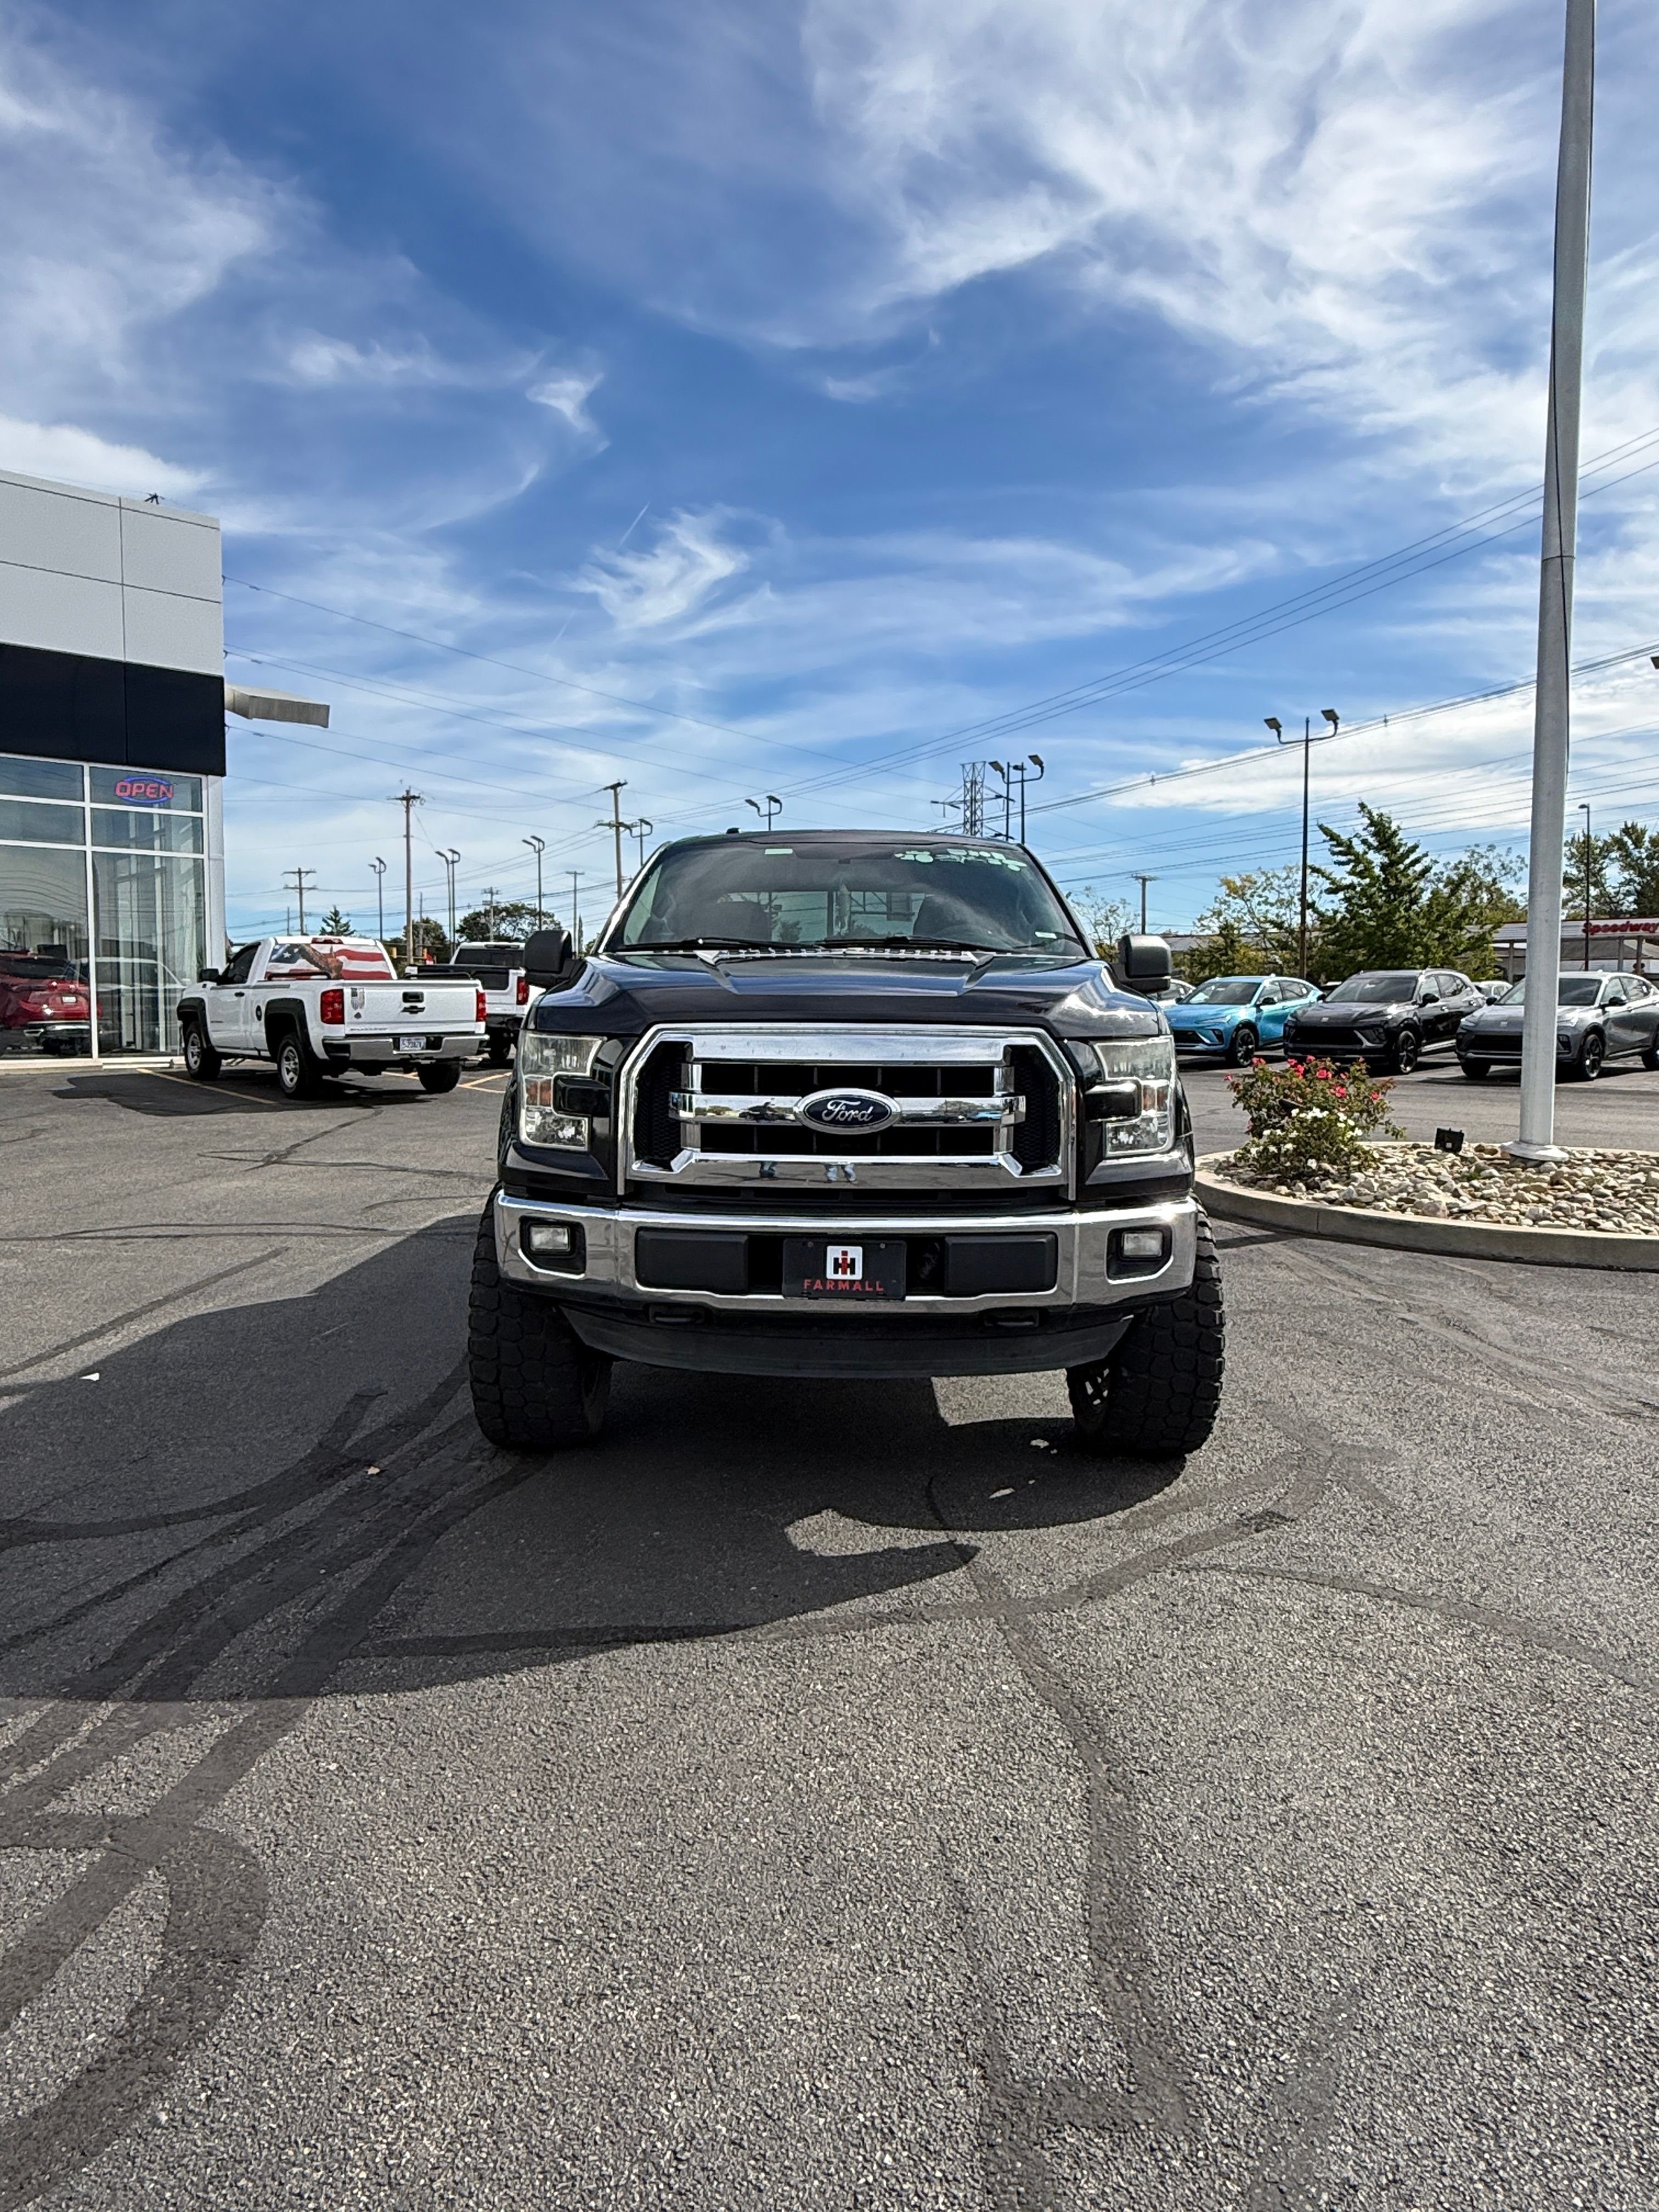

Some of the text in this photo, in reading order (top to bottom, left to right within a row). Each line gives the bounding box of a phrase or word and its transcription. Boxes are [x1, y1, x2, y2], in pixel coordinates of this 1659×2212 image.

[115, 781, 173, 799] OPEN
[822, 1099, 873, 1121] Ford
[803, 1279, 885, 1292] FARMALL
